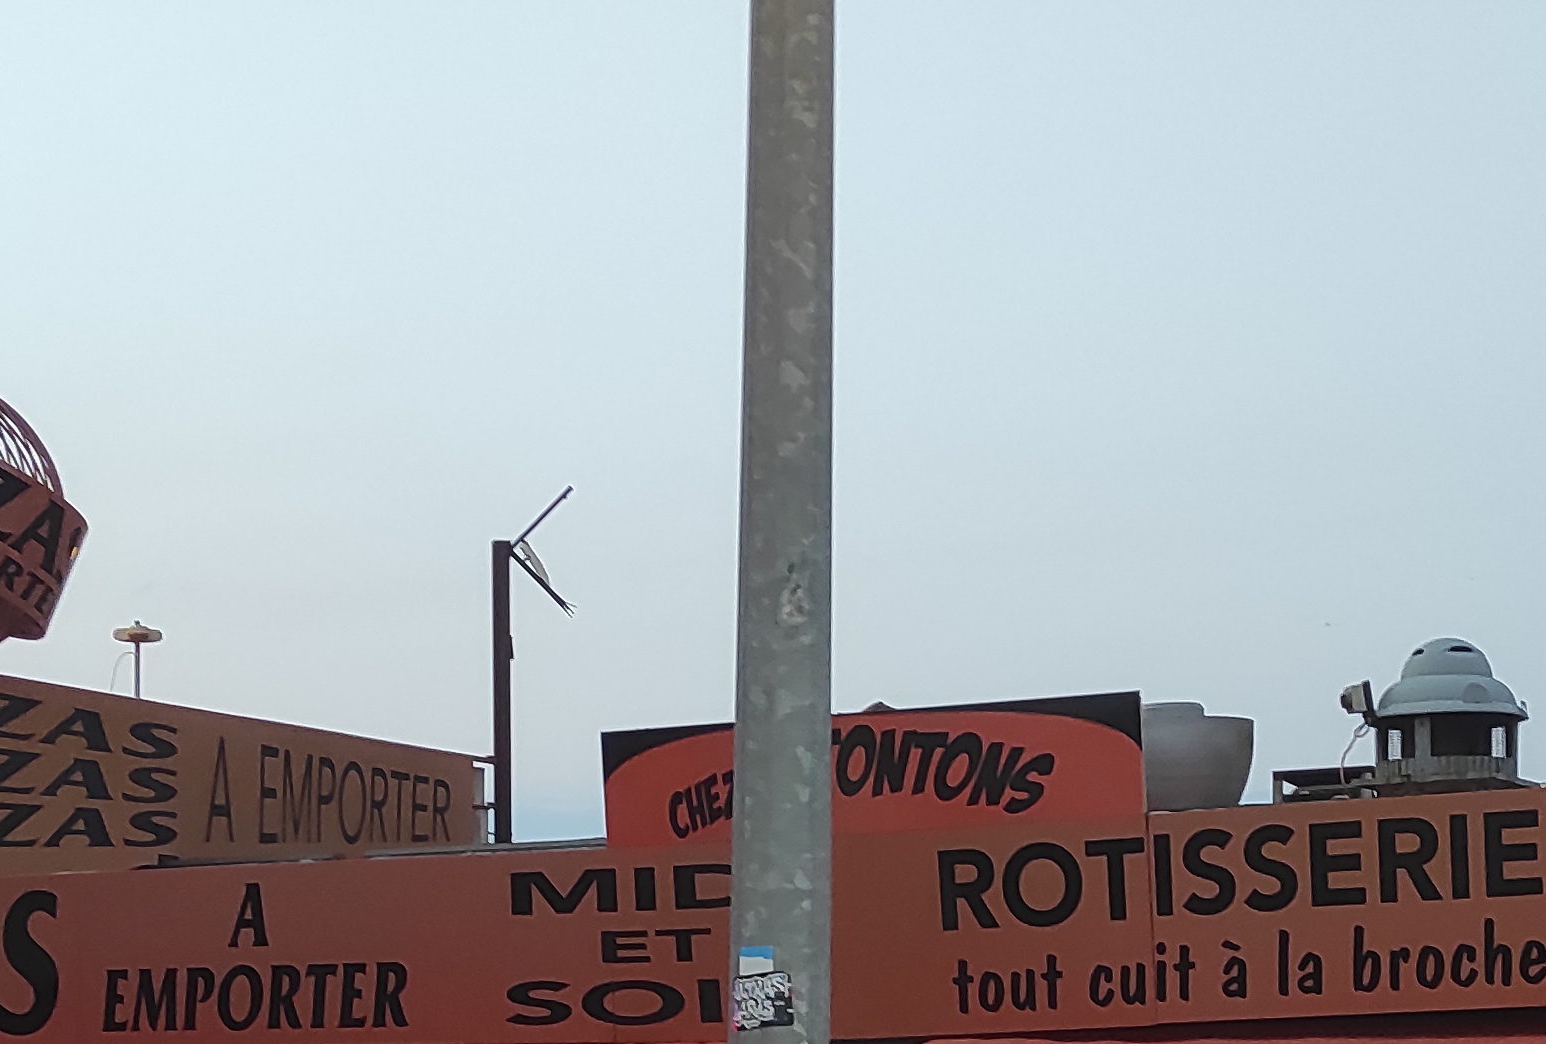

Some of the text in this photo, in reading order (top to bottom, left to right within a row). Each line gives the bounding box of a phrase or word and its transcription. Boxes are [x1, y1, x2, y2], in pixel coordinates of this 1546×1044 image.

[206, 736, 451, 845] A EMPORTER
[937, 809, 1544, 932] ROTISSERIE
[229, 882, 270, 949] A
[601, 928, 711, 963] ET
[102, 962, 409, 1034] EMPORTER
[954, 954, 1063, 1014] tout
[1089, 943, 1195, 1007] cuit
[1221, 940, 1247, 999] à
[1278, 929, 1323, 996] la
